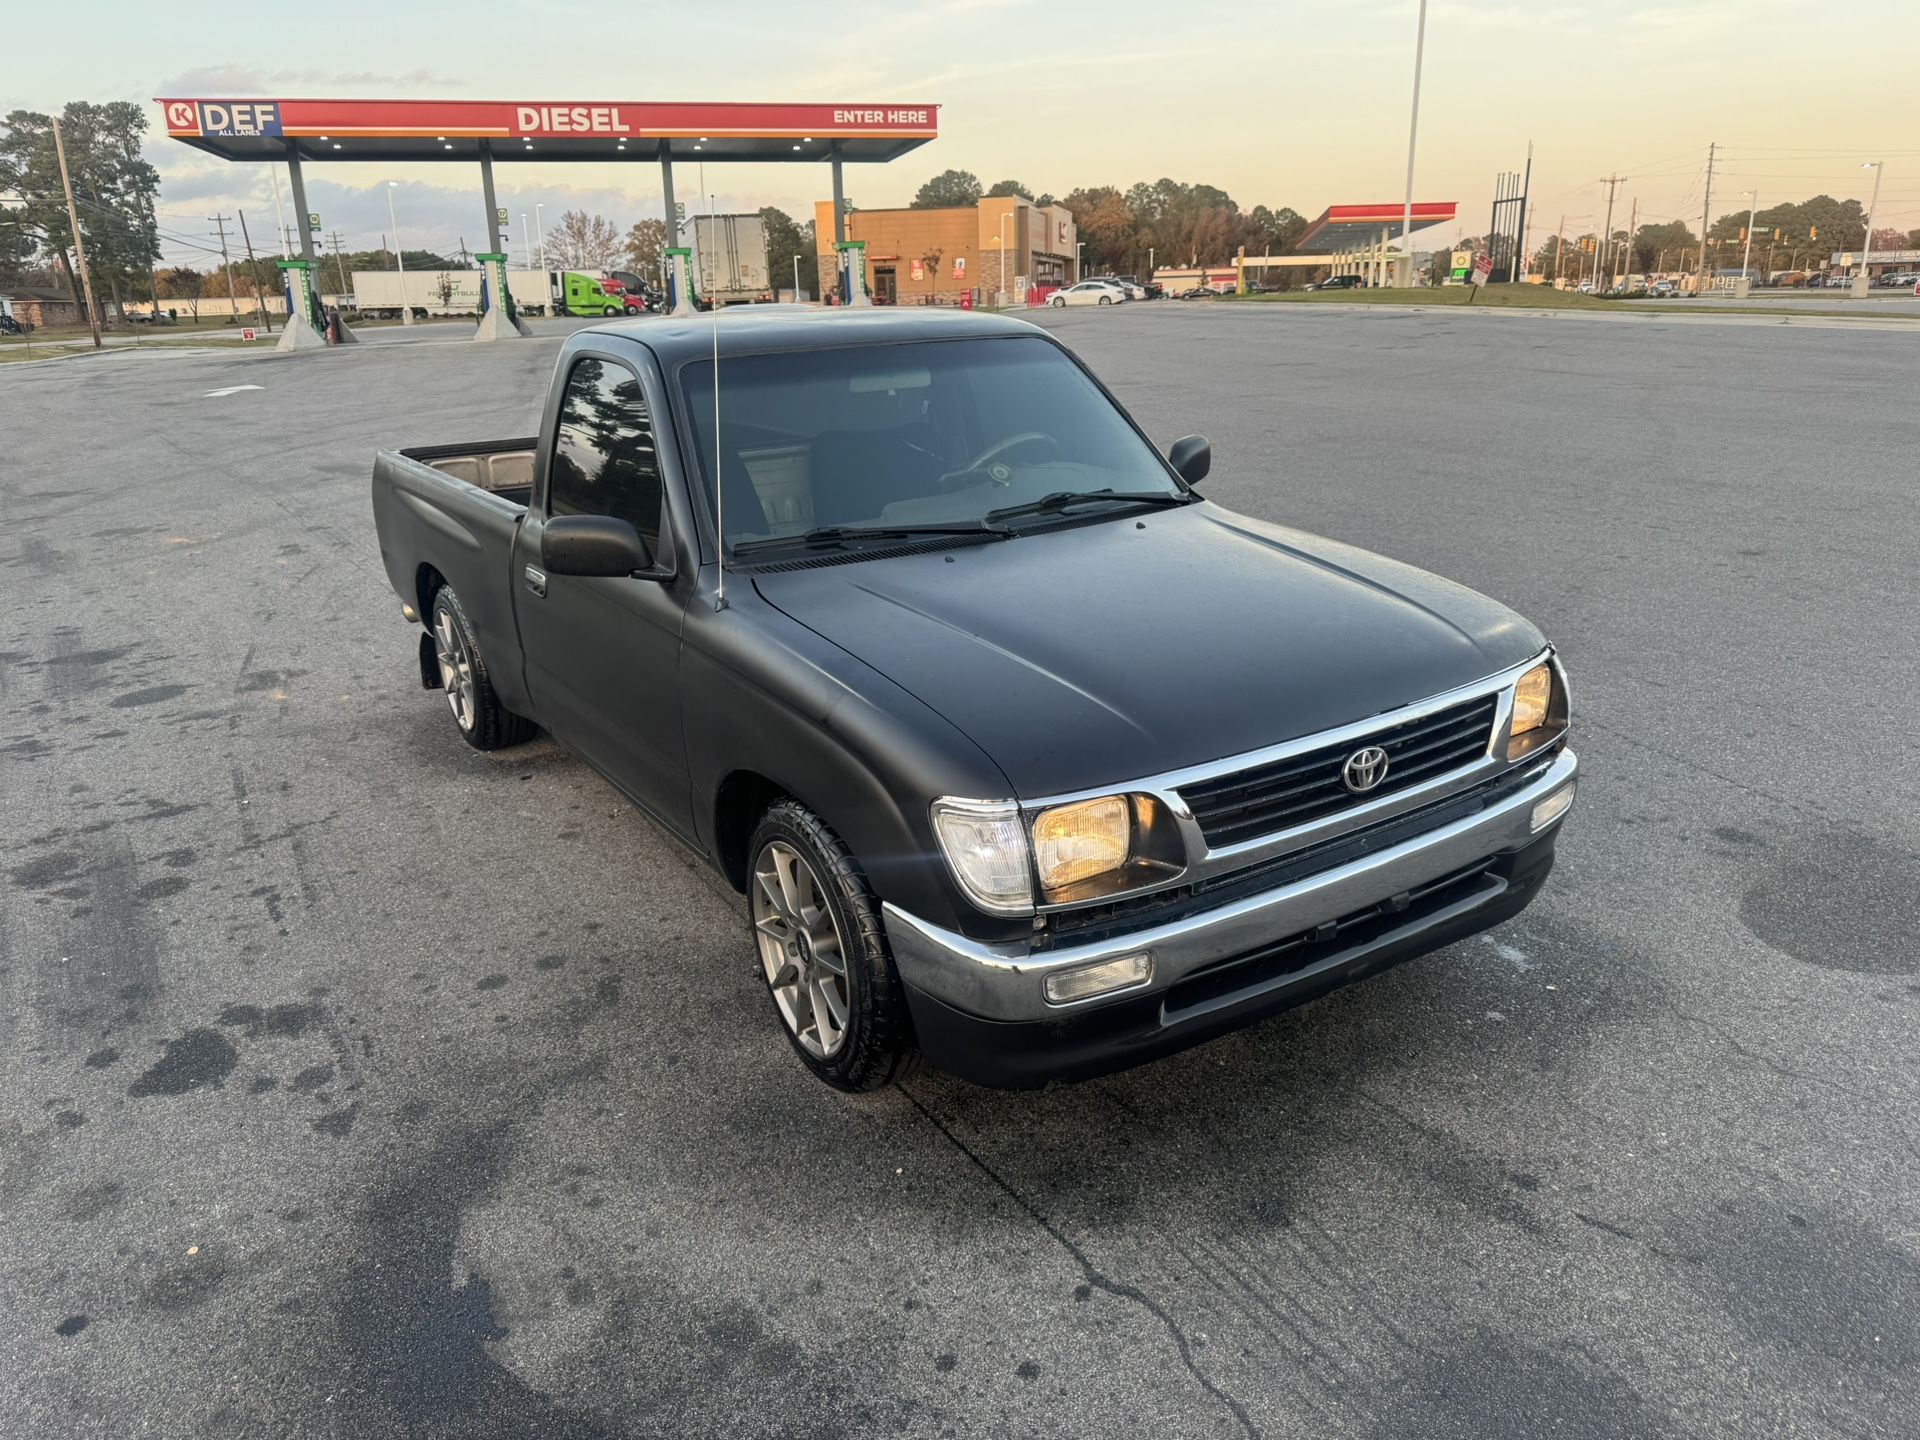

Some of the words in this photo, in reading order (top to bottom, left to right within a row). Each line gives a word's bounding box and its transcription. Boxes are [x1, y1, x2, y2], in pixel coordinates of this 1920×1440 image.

[173, 106, 191, 124] K
[203, 105, 274, 130] DEF
[517, 107, 630, 131] DIESEL
[833, 110, 884, 123] ENTER
[888, 110, 927, 123] HERE
